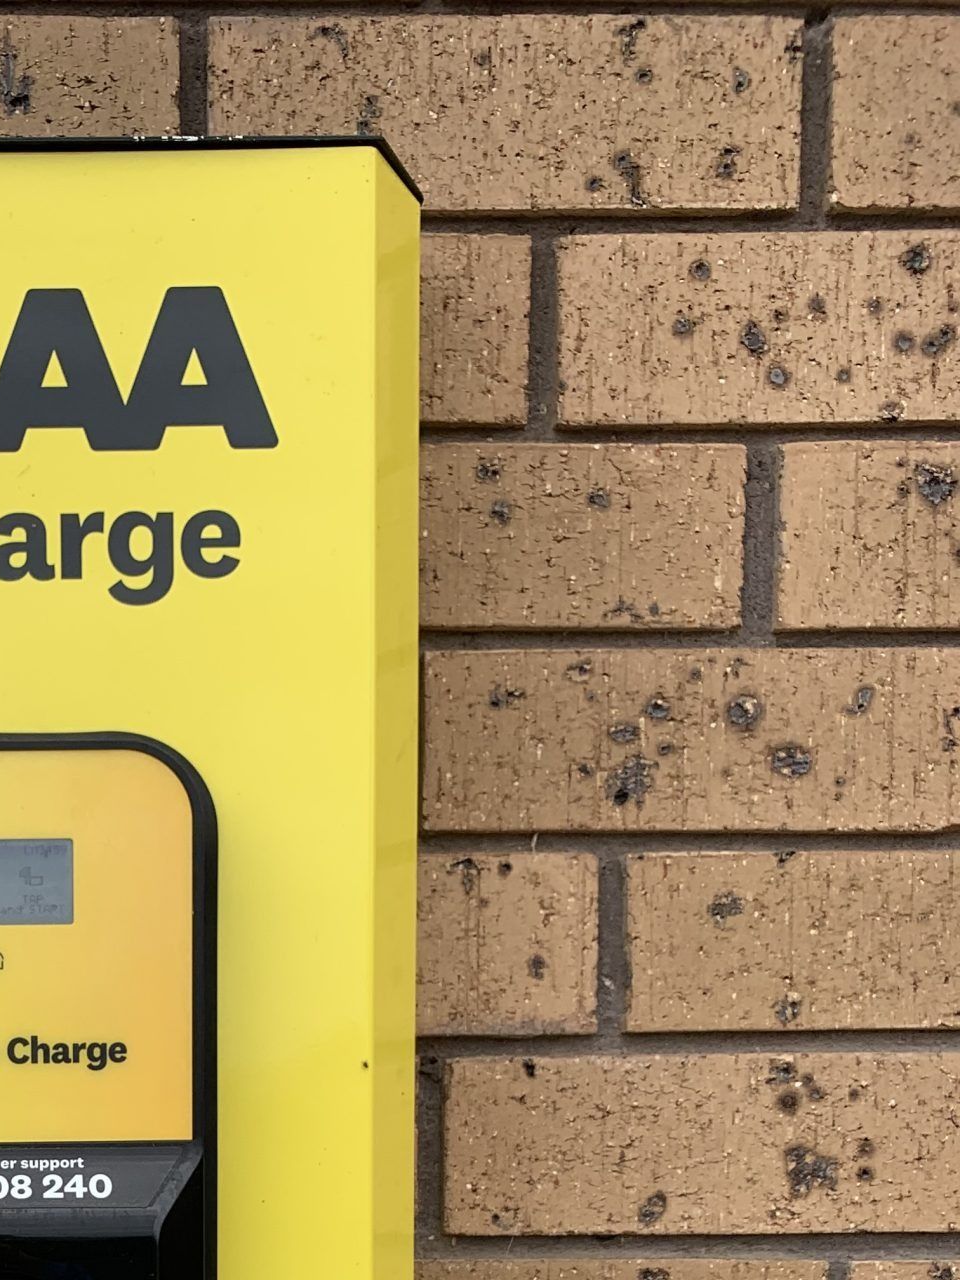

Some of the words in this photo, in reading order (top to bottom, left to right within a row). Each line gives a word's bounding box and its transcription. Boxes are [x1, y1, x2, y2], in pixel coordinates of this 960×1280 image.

[7, 1036, 128, 1070] Charge
[20, 1157, 84, 1172] support
[42, 1173, 112, 1198] 240
